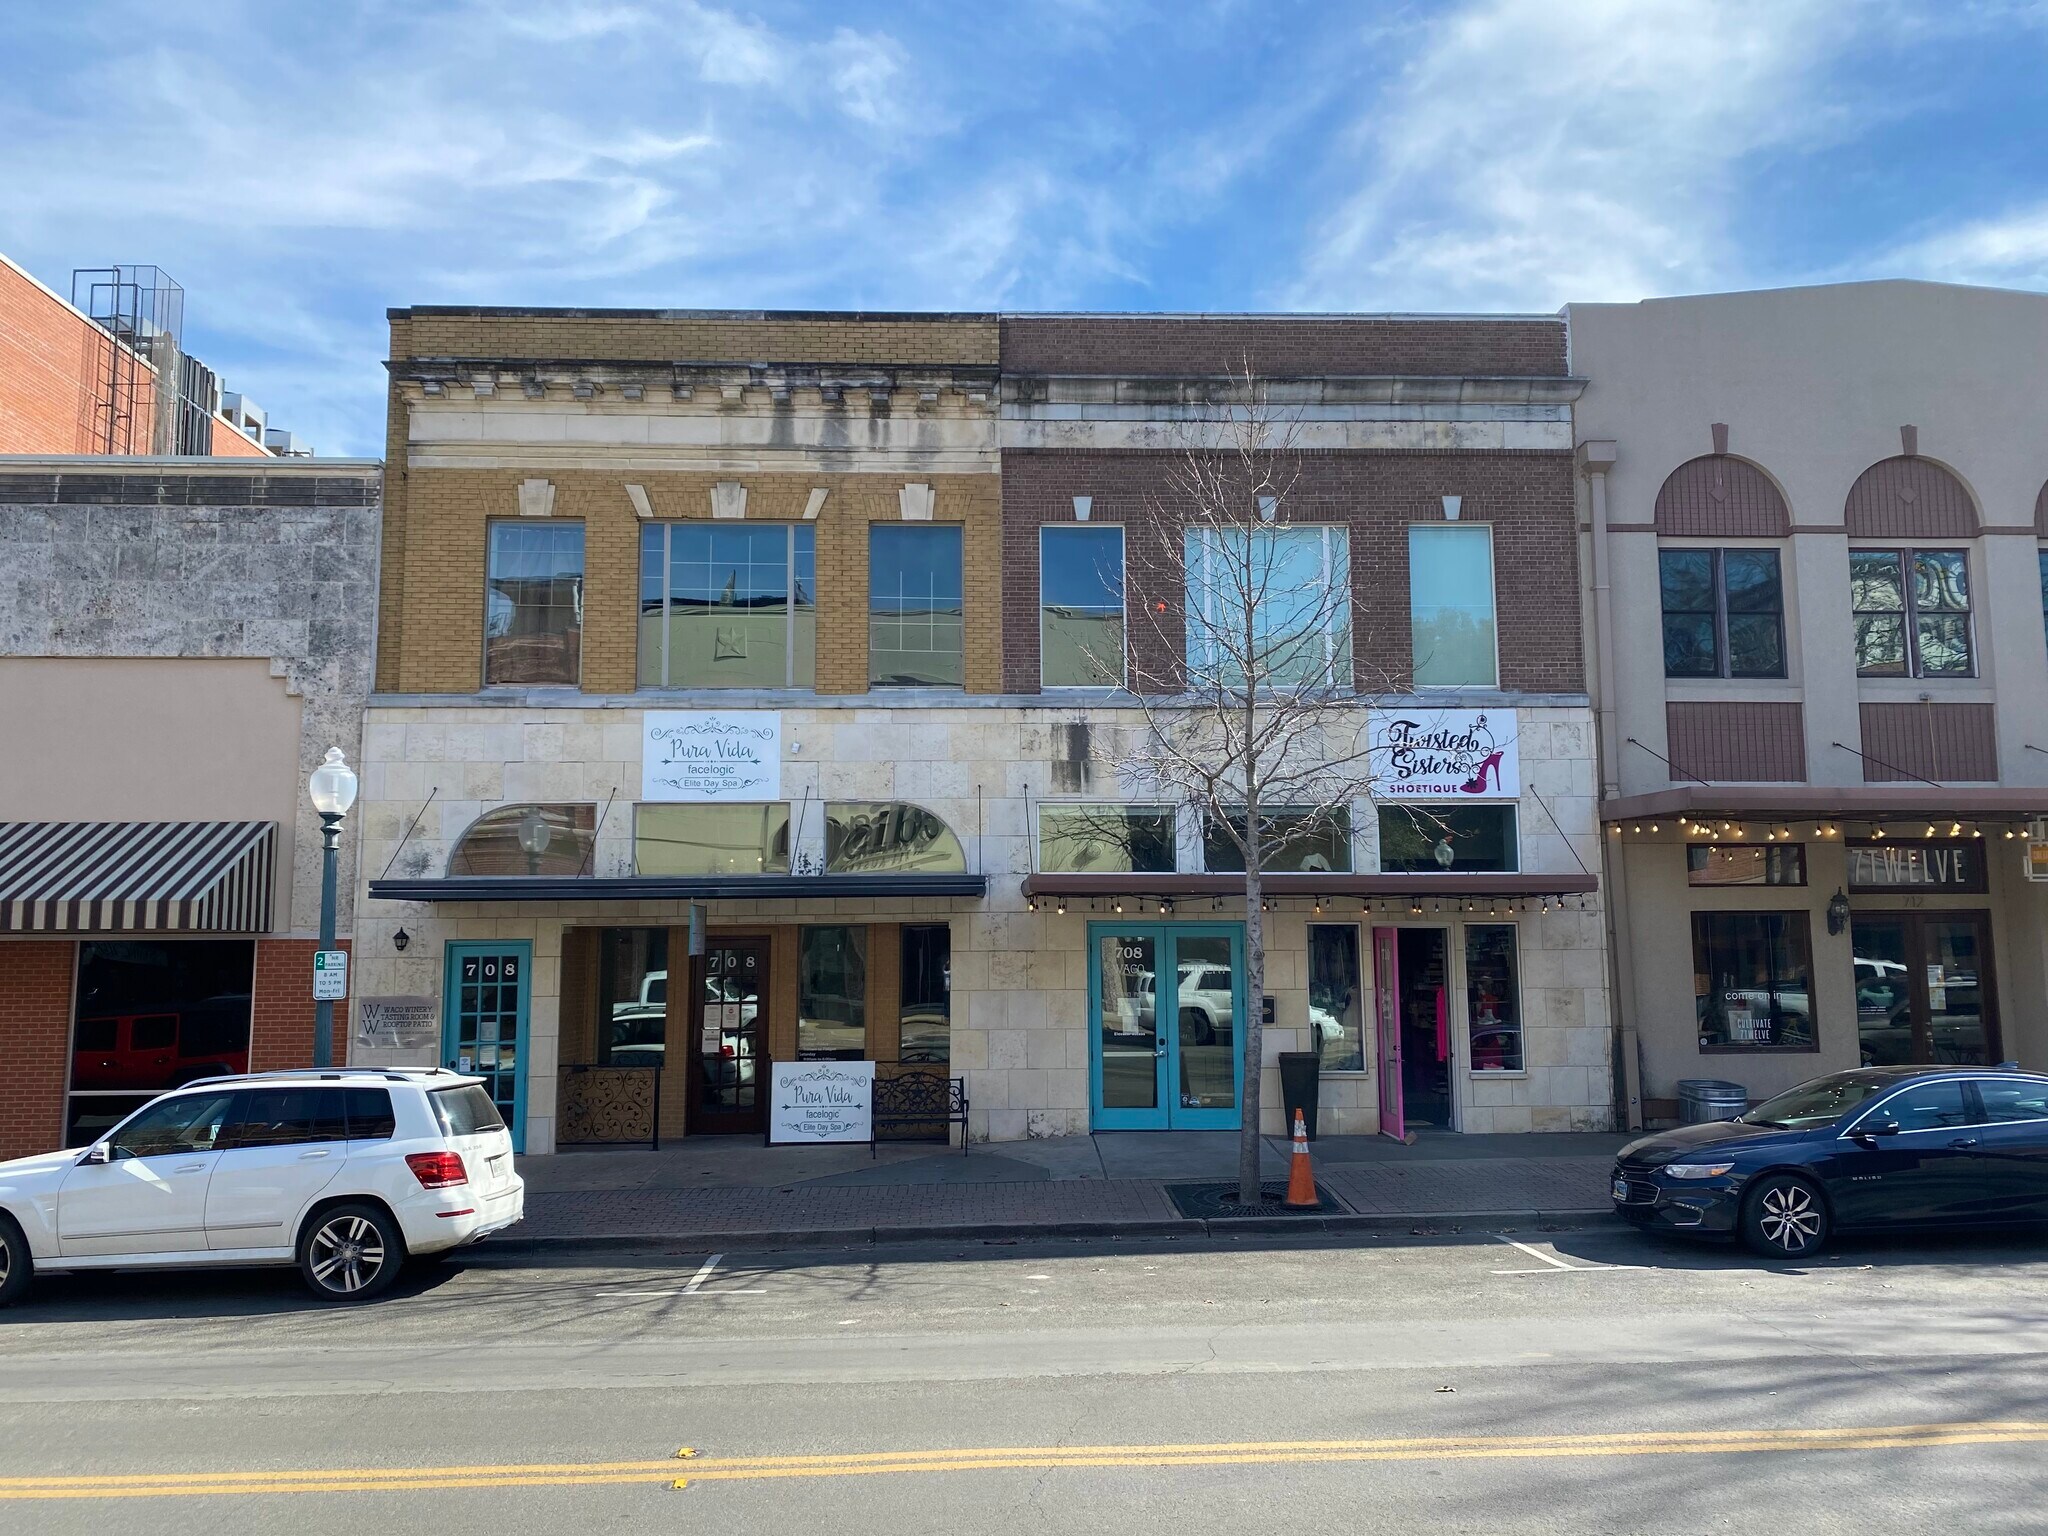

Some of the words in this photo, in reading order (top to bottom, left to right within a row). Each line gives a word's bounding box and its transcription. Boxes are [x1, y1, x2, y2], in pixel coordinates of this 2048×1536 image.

[1388, 719, 1479, 752] Twisted
[670, 738, 711, 758] Pura
[714, 738, 754, 758] Vida
[1391, 746, 1462, 778] Sisters
[687, 764, 735, 776] facelogic
[684, 779, 701, 787] Elite
[703, 779, 719, 788] Day
[722, 779, 738, 788] Spa
[1389, 784, 1458, 793] SHOETIQUE
[1852, 849, 1966, 883] 7TWELVE
[1115, 947, 1143, 959] 708
[317, 956, 324, 966] 2
[709, 956, 756, 968] 708
[466, 963, 515, 976] 708
[1725, 992, 1756, 1000] come
[1757, 992, 1771, 1000] on
[362, 1004, 381, 1019] W
[404, 1005, 433, 1013] WINERY
[380, 1013, 410, 1021] TASTING
[362, 1020, 380, 1035] W
[1737, 1018, 1772, 1029] CULTIVATE
[793, 1085, 823, 1105] Pura
[825, 1085, 853, 1104] Vida
[805, 1109, 840, 1121] facelogic
[803, 1123, 816, 1131] Elite
[817, 1123, 830, 1132] Day
[830, 1123, 842, 1132] Spa
